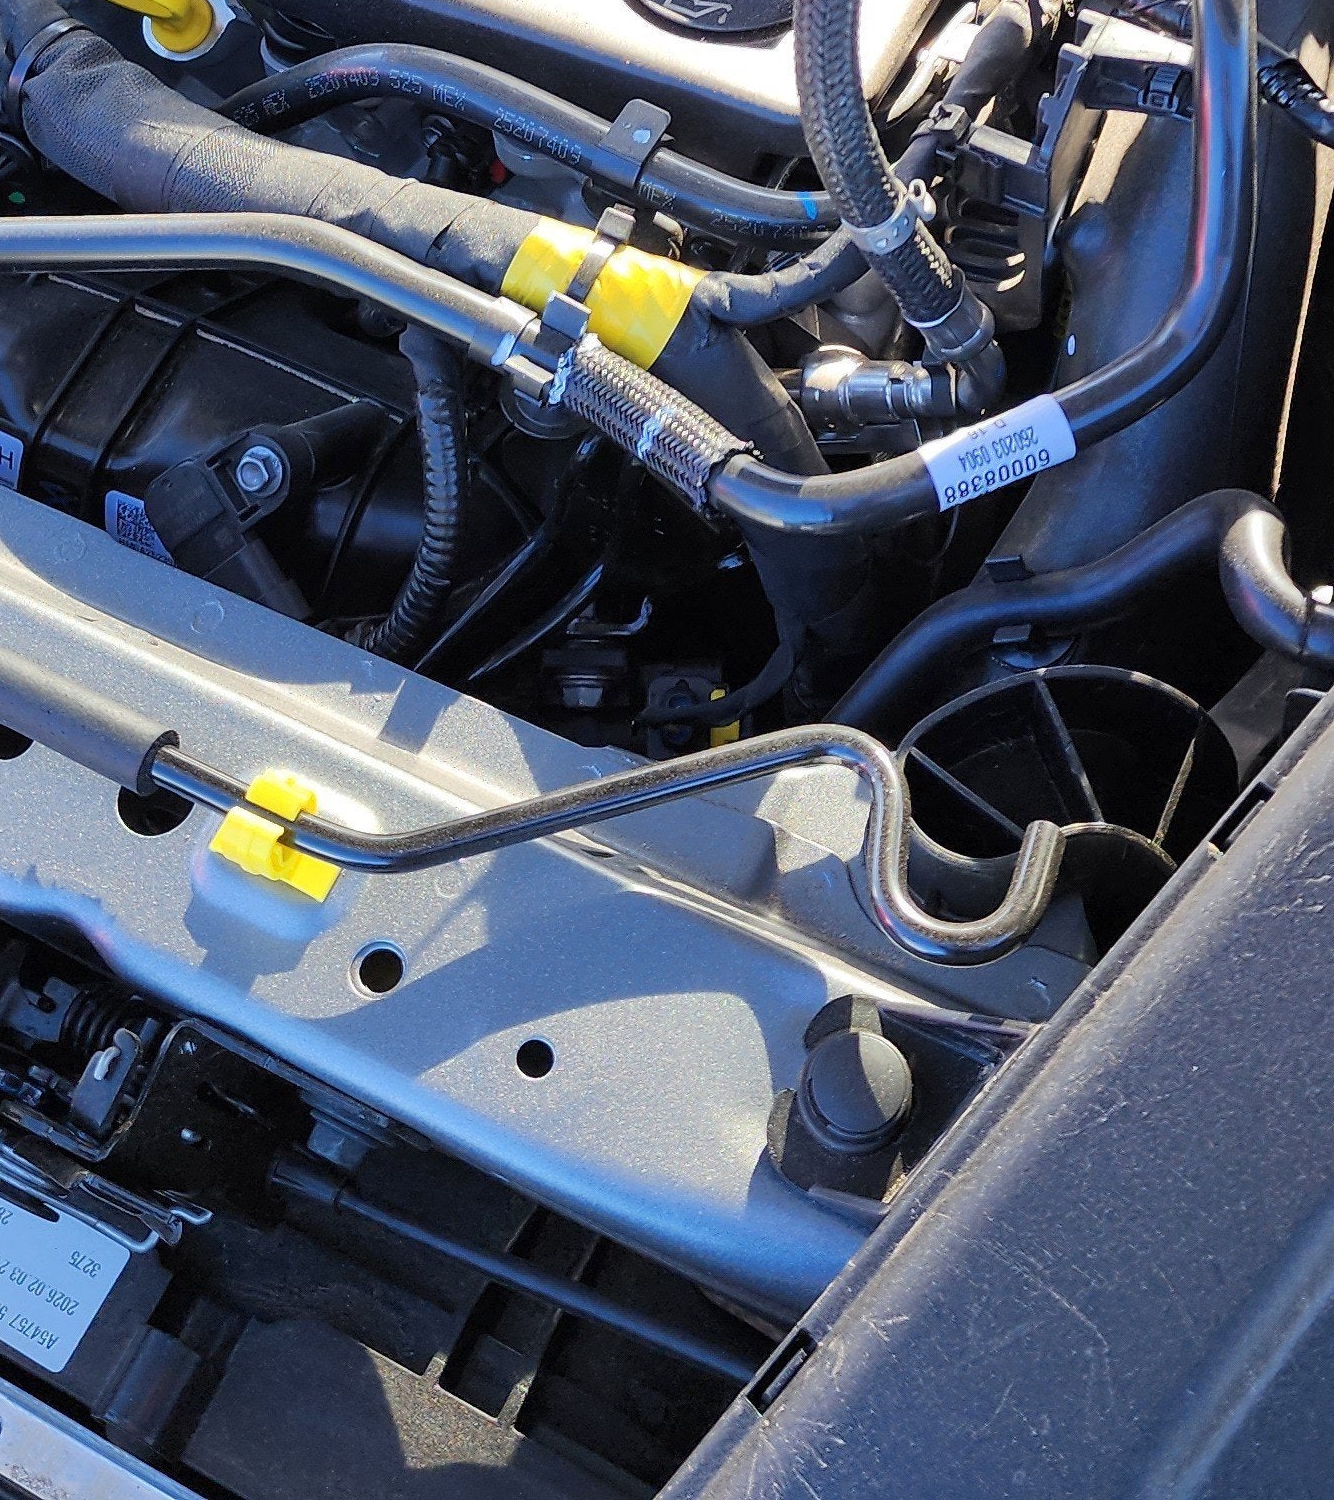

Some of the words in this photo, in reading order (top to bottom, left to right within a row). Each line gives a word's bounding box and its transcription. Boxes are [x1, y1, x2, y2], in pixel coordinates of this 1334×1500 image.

[389, 68, 424, 95] 525
[432, 82, 467, 111] MEX
[493, 106, 583, 165] 25207409
[958, 444, 991, 473] 0904
[991, 425, 1039, 460] 260203
[944, 448, 1051, 504] 60008388
[68, 1250, 102, 1278] 3275
[9, 1265, 80, 1317] 2026.02.03
[8, 1313, 60, 1350] A54757
